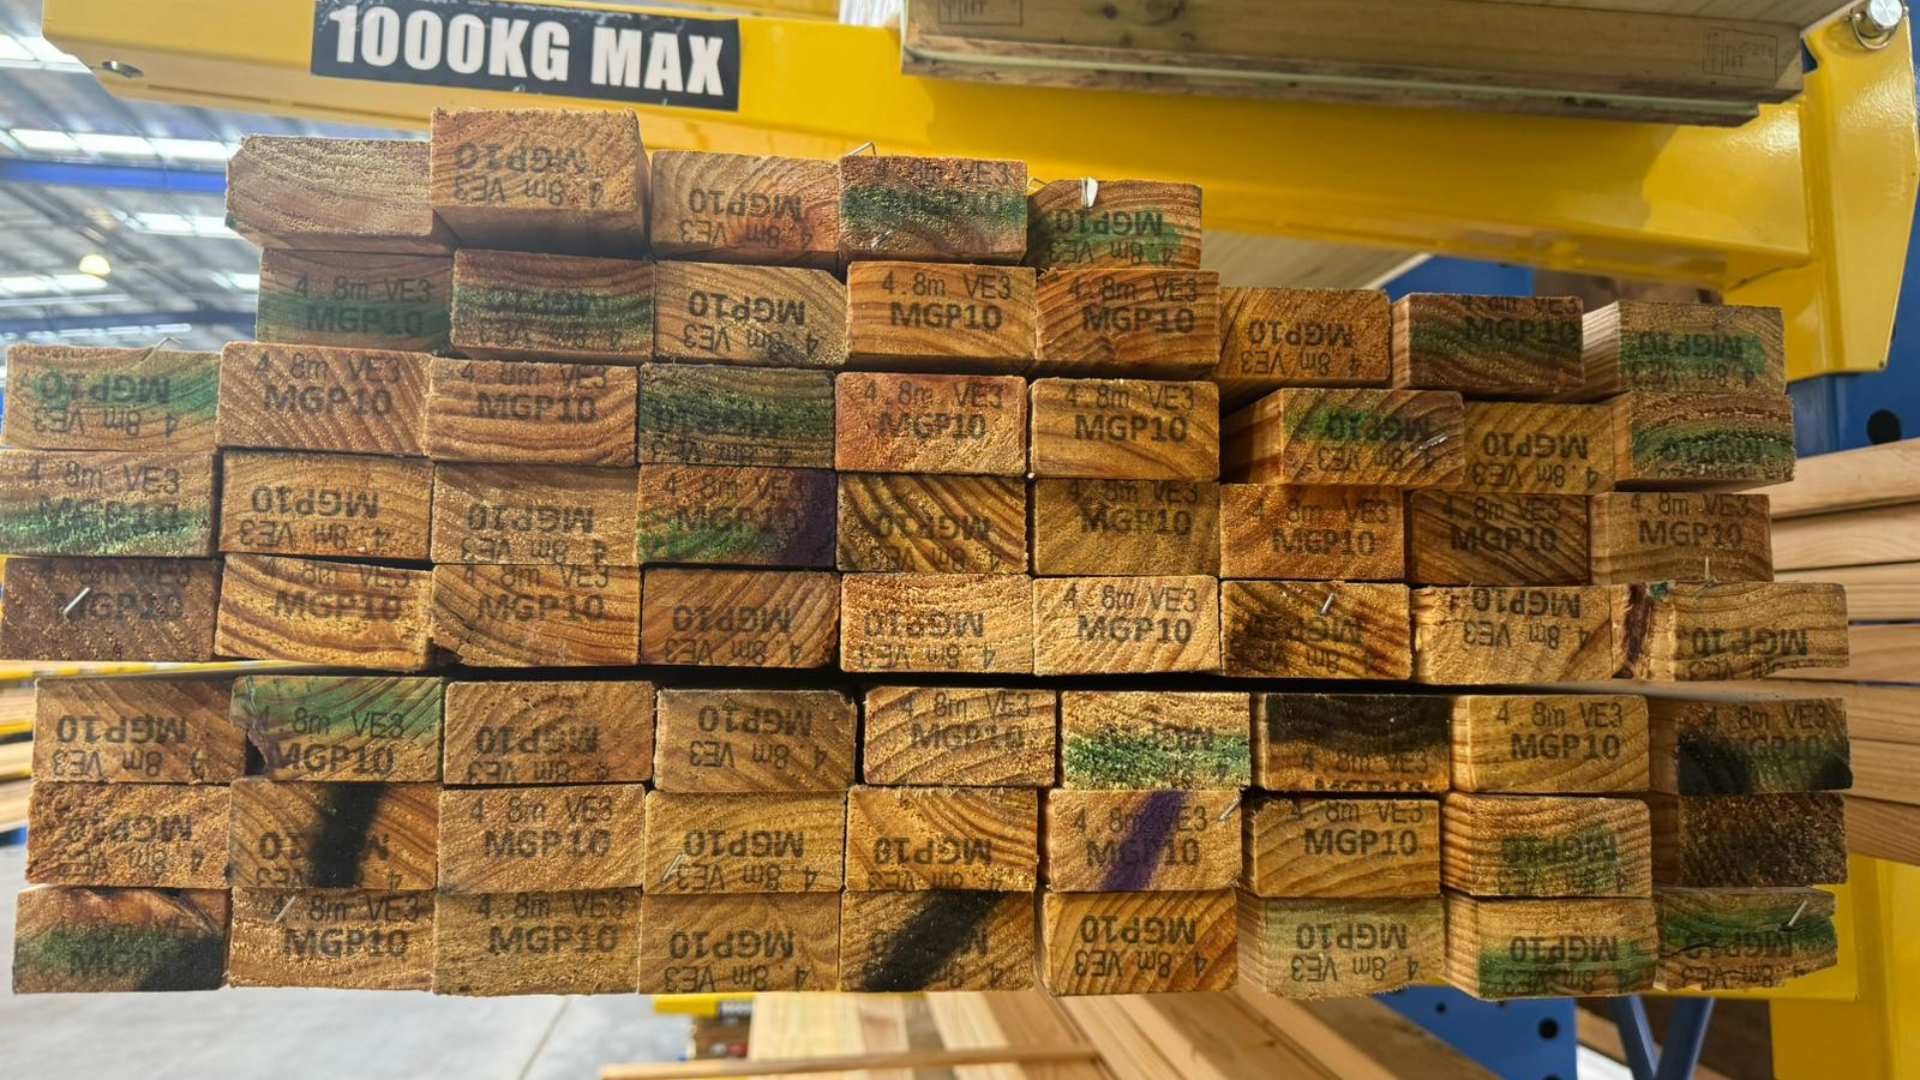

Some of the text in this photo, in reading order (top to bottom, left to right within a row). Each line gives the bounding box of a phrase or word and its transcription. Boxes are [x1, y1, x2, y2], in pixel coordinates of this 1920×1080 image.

[330, 4, 725, 97] 1000KG MAX
[453, 175, 505, 203] VE3
[689, 188, 800, 219] MGP10
[679, 219, 725, 243] VE3
[1055, 207, 1162, 234] MGP10
[1047, 239, 1094, 262] VE3
[385, 279, 431, 301] VE3
[964, 274, 1012, 299] VE3
[1152, 278, 1198, 302] VE3
[304, 307, 422, 333] MGP10
[689, 292, 805, 325] MGP10
[891, 301, 1002, 330] MGP10
[1082, 304, 1195, 334] MGP10
[684, 324, 729, 351] VE3
[1248, 320, 1354, 347] MGP10
[347, 357, 399, 383] VE3
[1241, 350, 1288, 374] VE3
[40, 371, 170, 402] MGP10
[954, 383, 1002, 407] VE3
[1148, 385, 1194, 410] VE3
[264, 387, 392, 416] MGP10
[478, 395, 597, 421] MGP10
[1075, 415, 1188, 442] MGP10
[1484, 433, 1588, 460] MGP10
[123, 464, 179, 493] VE3
[757, 476, 802, 495] VE
[1473, 463, 1520, 487] VE3
[252, 486, 378, 517] MGP10
[1343, 501, 1388, 524] VE3
[1702, 495, 1749, 515] VE3
[240, 520, 296, 548] VE3
[1638, 520, 1743, 548] MGP10
[561, 565, 608, 588] VE3
[478, 594, 606, 621] MGP10
[1150, 587, 1196, 612] VE3
[1472, 588, 1581, 618] MGP10
[673, 605, 795, 634] MGP10
[864, 612, 985, 637] MGP10
[1078, 615, 1192, 643] MGP10
[1257, 617, 1362, 645] MGP
[1463, 621, 1510, 646] VE3
[985, 693, 1030, 717] VE3
[1580, 703, 1623, 728] VE3
[57, 717, 187, 744] MGP10
[352, 710, 403, 736] VE3
[698, 706, 811, 734] MGP10
[689, 741, 735, 767] VE3
[1511, 734, 1621, 761] MGP10
[53, 749, 103, 775] VE3
[566, 797, 612, 822] VE3
[1160, 808, 1207, 832] E3
[258, 832, 388, 859] M10
[485, 830, 611, 858] MGP10
[685, 832, 803, 858] MGP10
[874, 837, 992, 864] MGP10
[1305, 829, 1417, 856] MGP10
[678, 864, 724, 890] VE3
[366, 897, 419, 921] VE3
[575, 894, 625, 918] VE3
[285, 928, 408, 956] MGP10
[1082, 916, 1195, 944] MGP10
[1296, 923, 1407, 949] MGP10
[670, 930, 795, 958] MGP10
[1510, 936, 1618, 961] MGP10
[1075, 950, 1122, 976] VE3
[1291, 955, 1337, 981] VE3
[664, 965, 714, 992] VE3
